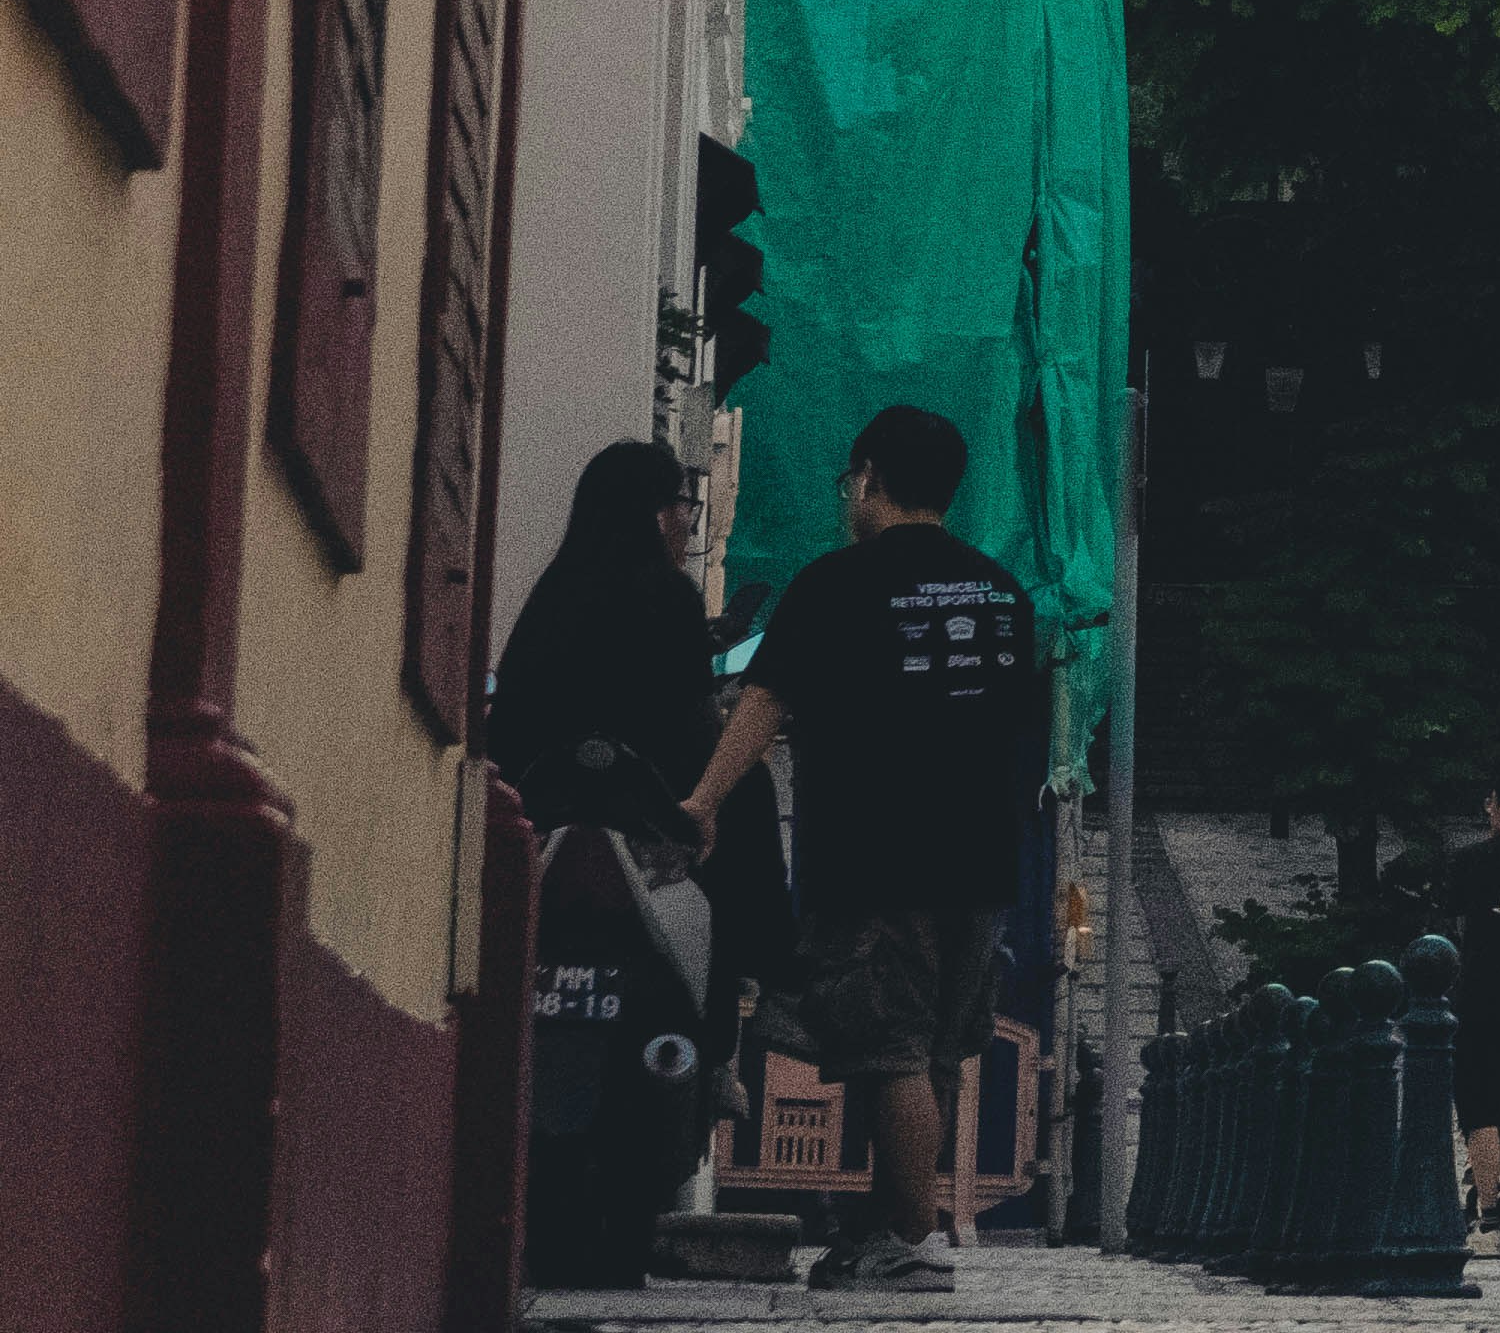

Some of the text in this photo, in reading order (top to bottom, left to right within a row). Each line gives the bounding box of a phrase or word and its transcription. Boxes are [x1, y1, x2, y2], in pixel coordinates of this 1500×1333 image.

[890, 591, 1016, 608] RETRO SPORTS CLUB
[554, 965, 596, 991] MM
